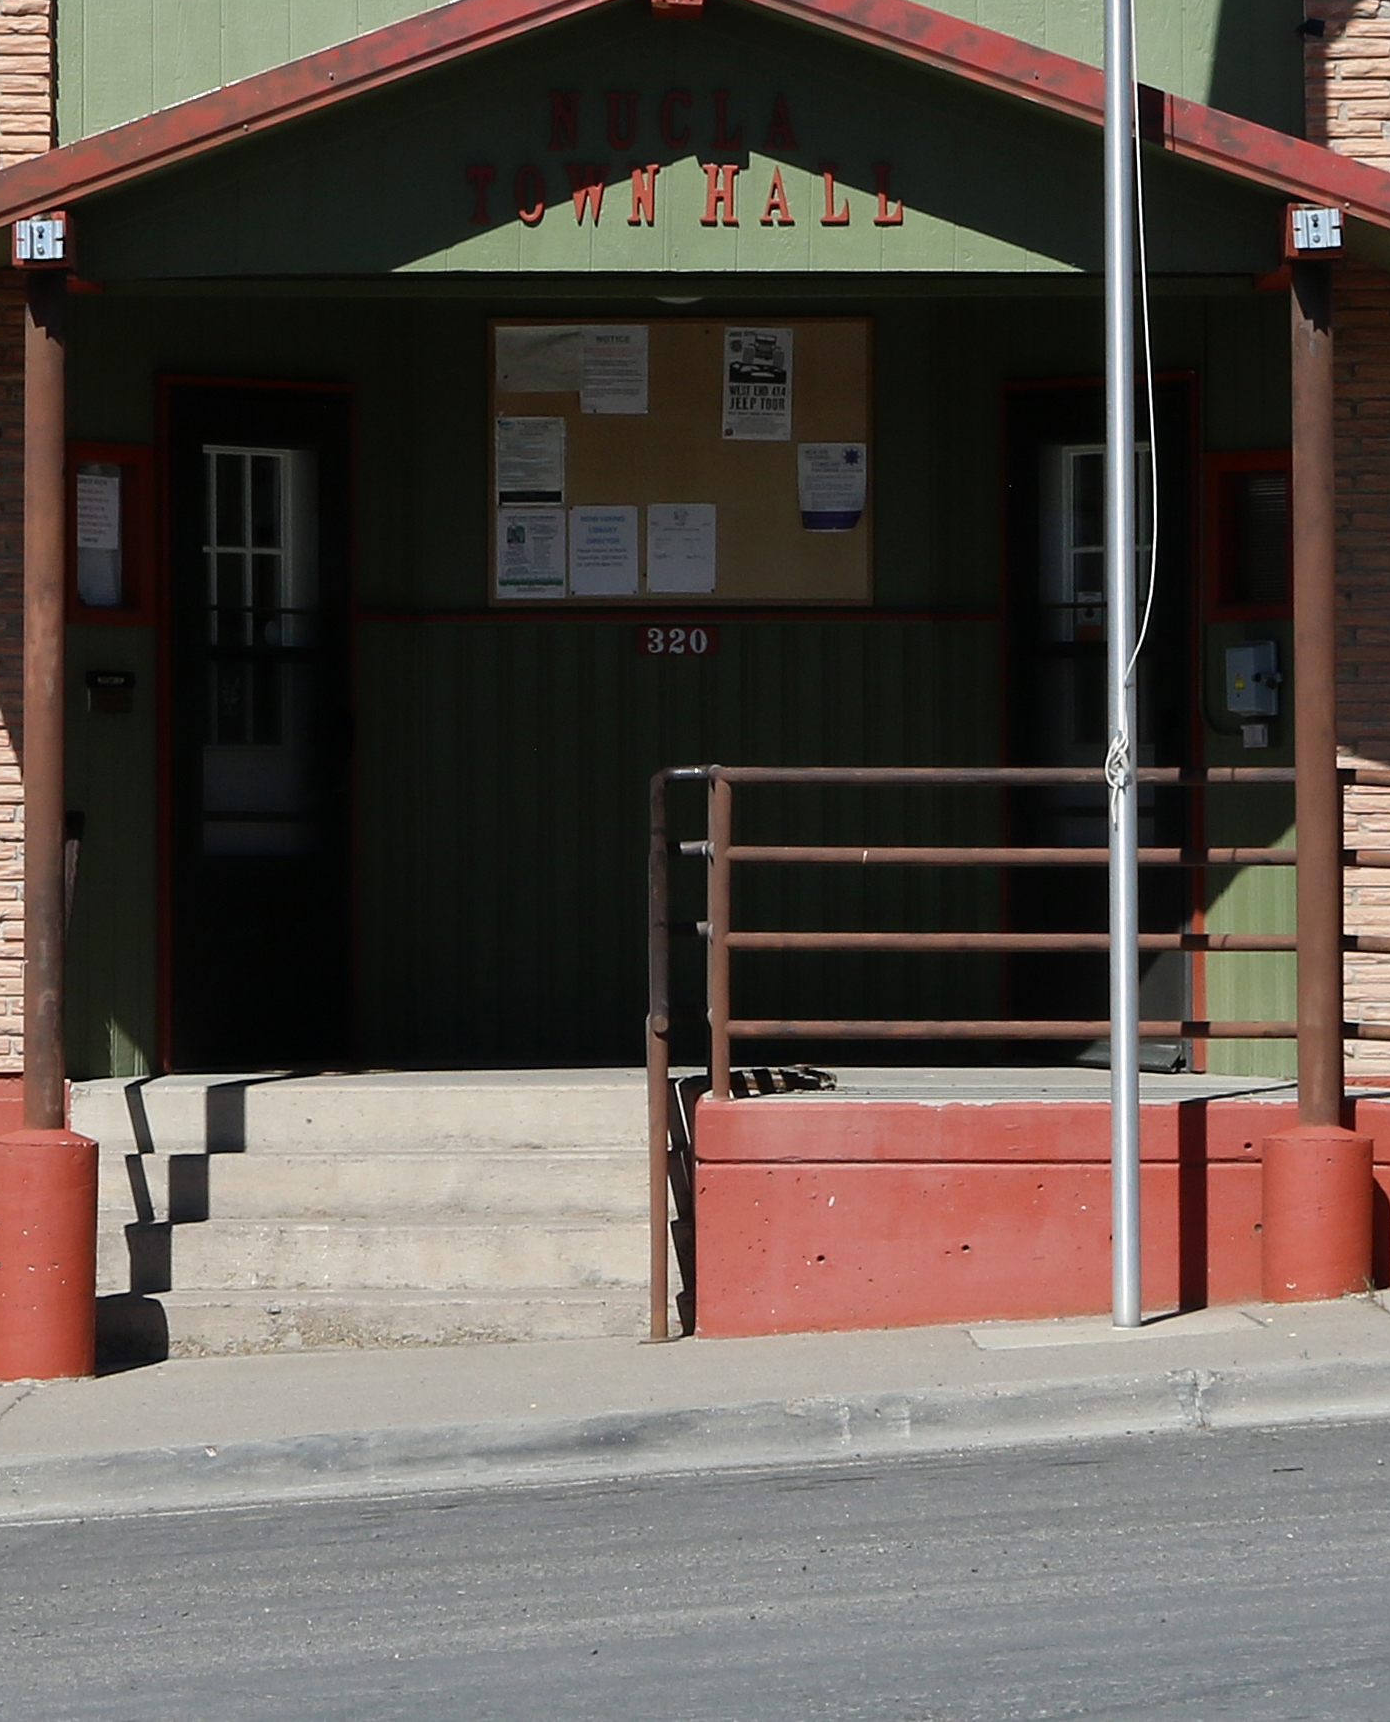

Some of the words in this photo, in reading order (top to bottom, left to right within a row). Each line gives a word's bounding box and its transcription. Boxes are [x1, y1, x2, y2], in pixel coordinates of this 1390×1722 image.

[548, 90, 799, 151] NUCLA
[466, 163, 660, 226] TOWN
[700, 163, 904, 226] HALL
[596, 335, 631, 344] NOTICE
[729, 385, 750, 395] WEST
[729, 397, 756, 410] JEEP
[761, 397, 785, 411] TOUR
[648, 627, 708, 654] 320
